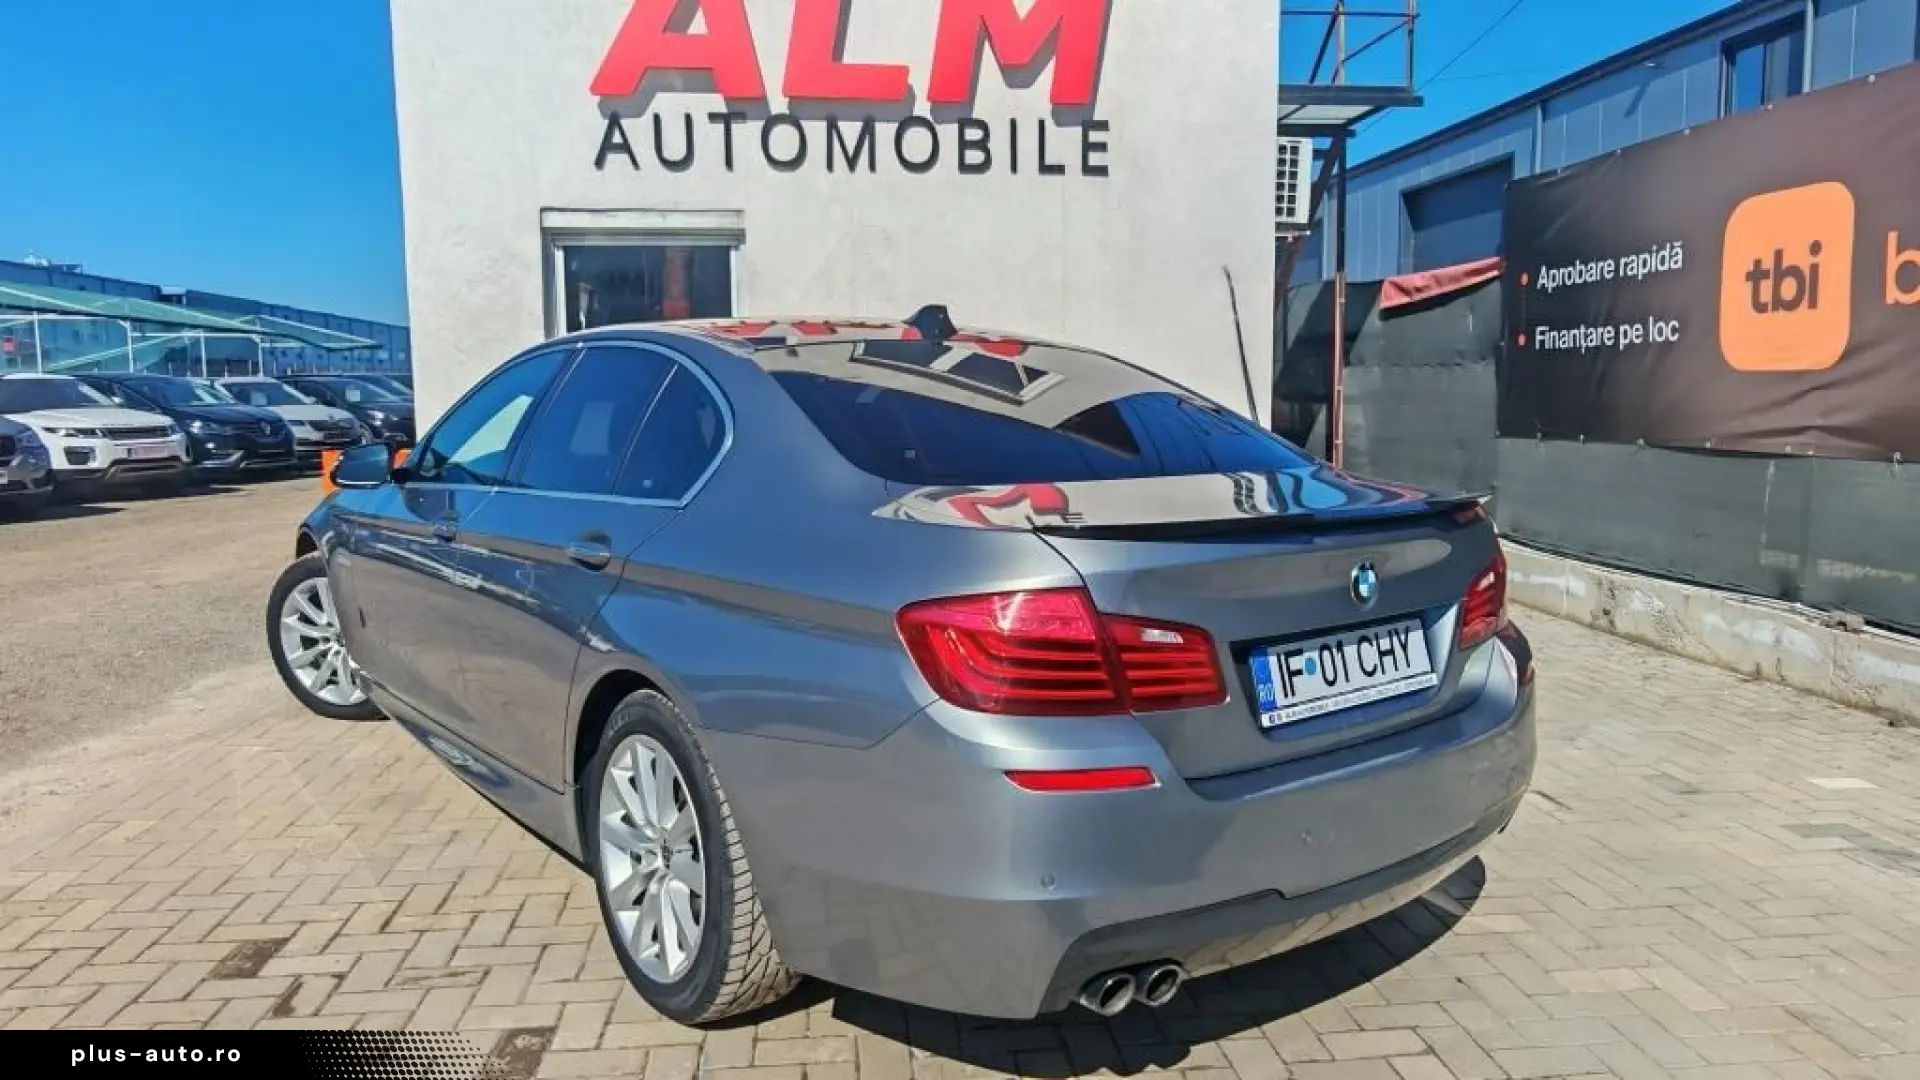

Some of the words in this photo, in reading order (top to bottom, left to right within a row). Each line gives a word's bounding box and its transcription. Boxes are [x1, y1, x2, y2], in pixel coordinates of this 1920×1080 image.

[589, 0, 1110, 105] ALM
[594, 110, 1110, 177] AUTOMOBILE
[1536, 259, 1615, 293] Aprobare
[1619, 240, 1683, 280] rapidă
[1745, 239, 1822, 313] tbi
[1535, 324, 1615, 354] Finanțare
[1619, 323, 1643, 351] pe
[1649, 315, 1680, 344] loc
[1276, 648, 1304, 699] IF
[1318, 639, 1350, 687] 01
[1356, 625, 1412, 677] CHY
